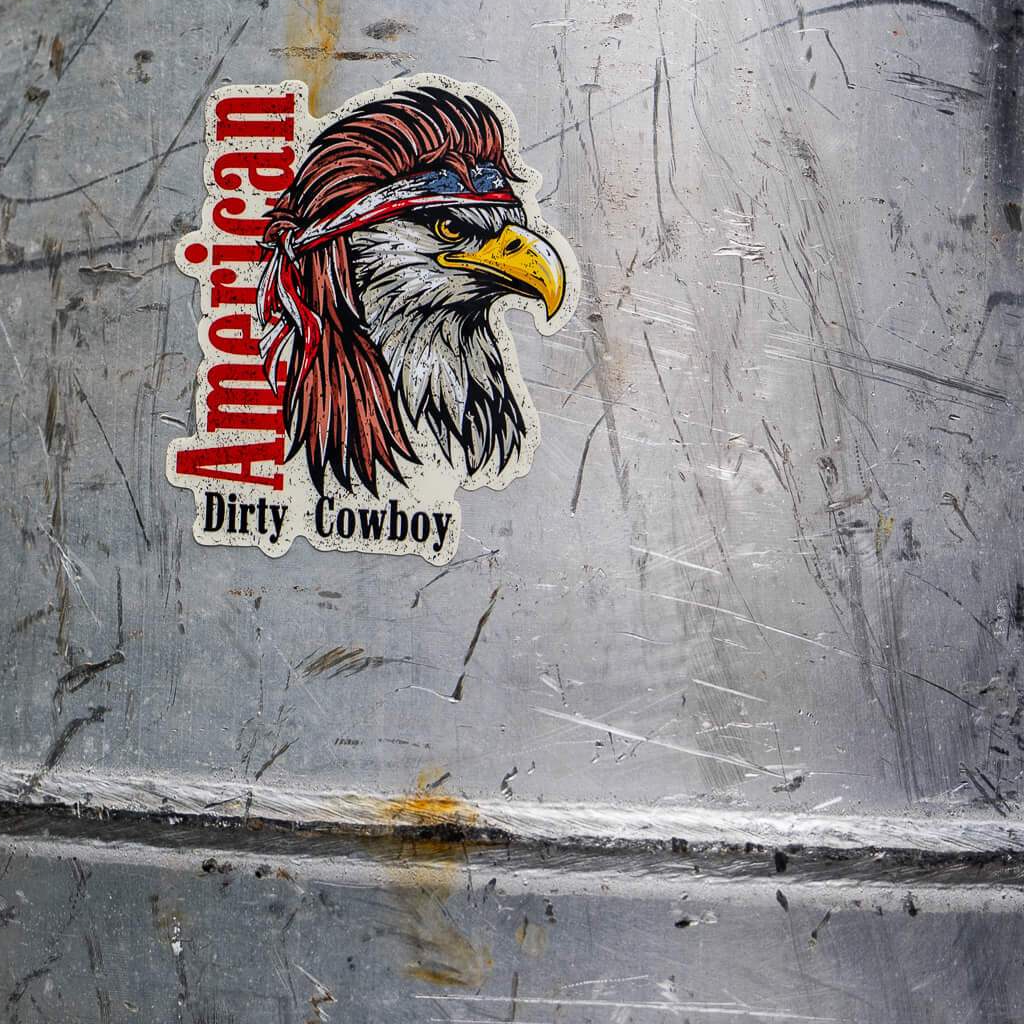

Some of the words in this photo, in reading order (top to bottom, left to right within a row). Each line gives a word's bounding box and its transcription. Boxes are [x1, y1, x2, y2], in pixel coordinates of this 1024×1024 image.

[176, 93, 295, 491] American
[204, 492, 288, 544] Dirty
[315, 495, 452, 552] Cowboy
